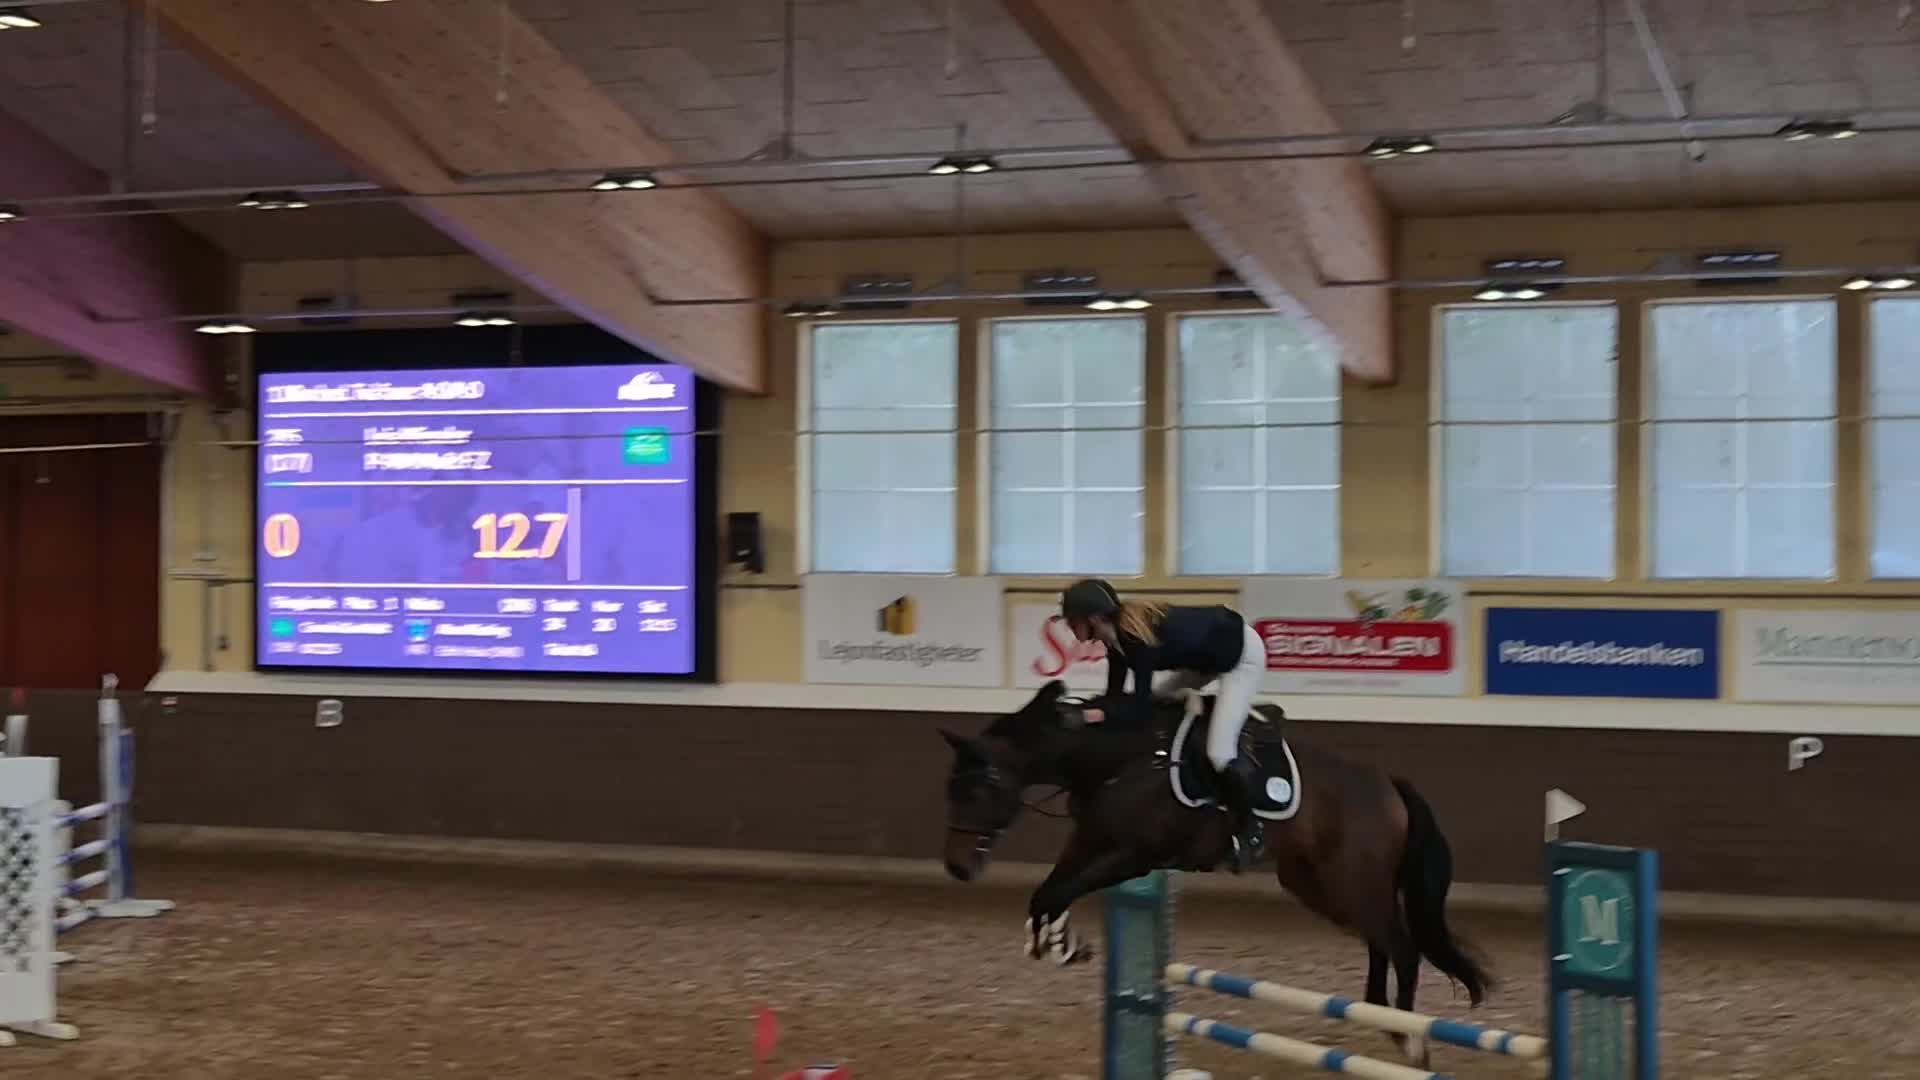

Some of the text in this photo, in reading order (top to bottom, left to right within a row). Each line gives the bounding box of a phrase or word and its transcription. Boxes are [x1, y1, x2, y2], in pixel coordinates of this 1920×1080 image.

[1499, 640, 1704, 667] Handelsbanken
[314, 699, 344, 728] B
[1789, 736, 1824, 771] P
[1579, 895, 1619, 946] M
